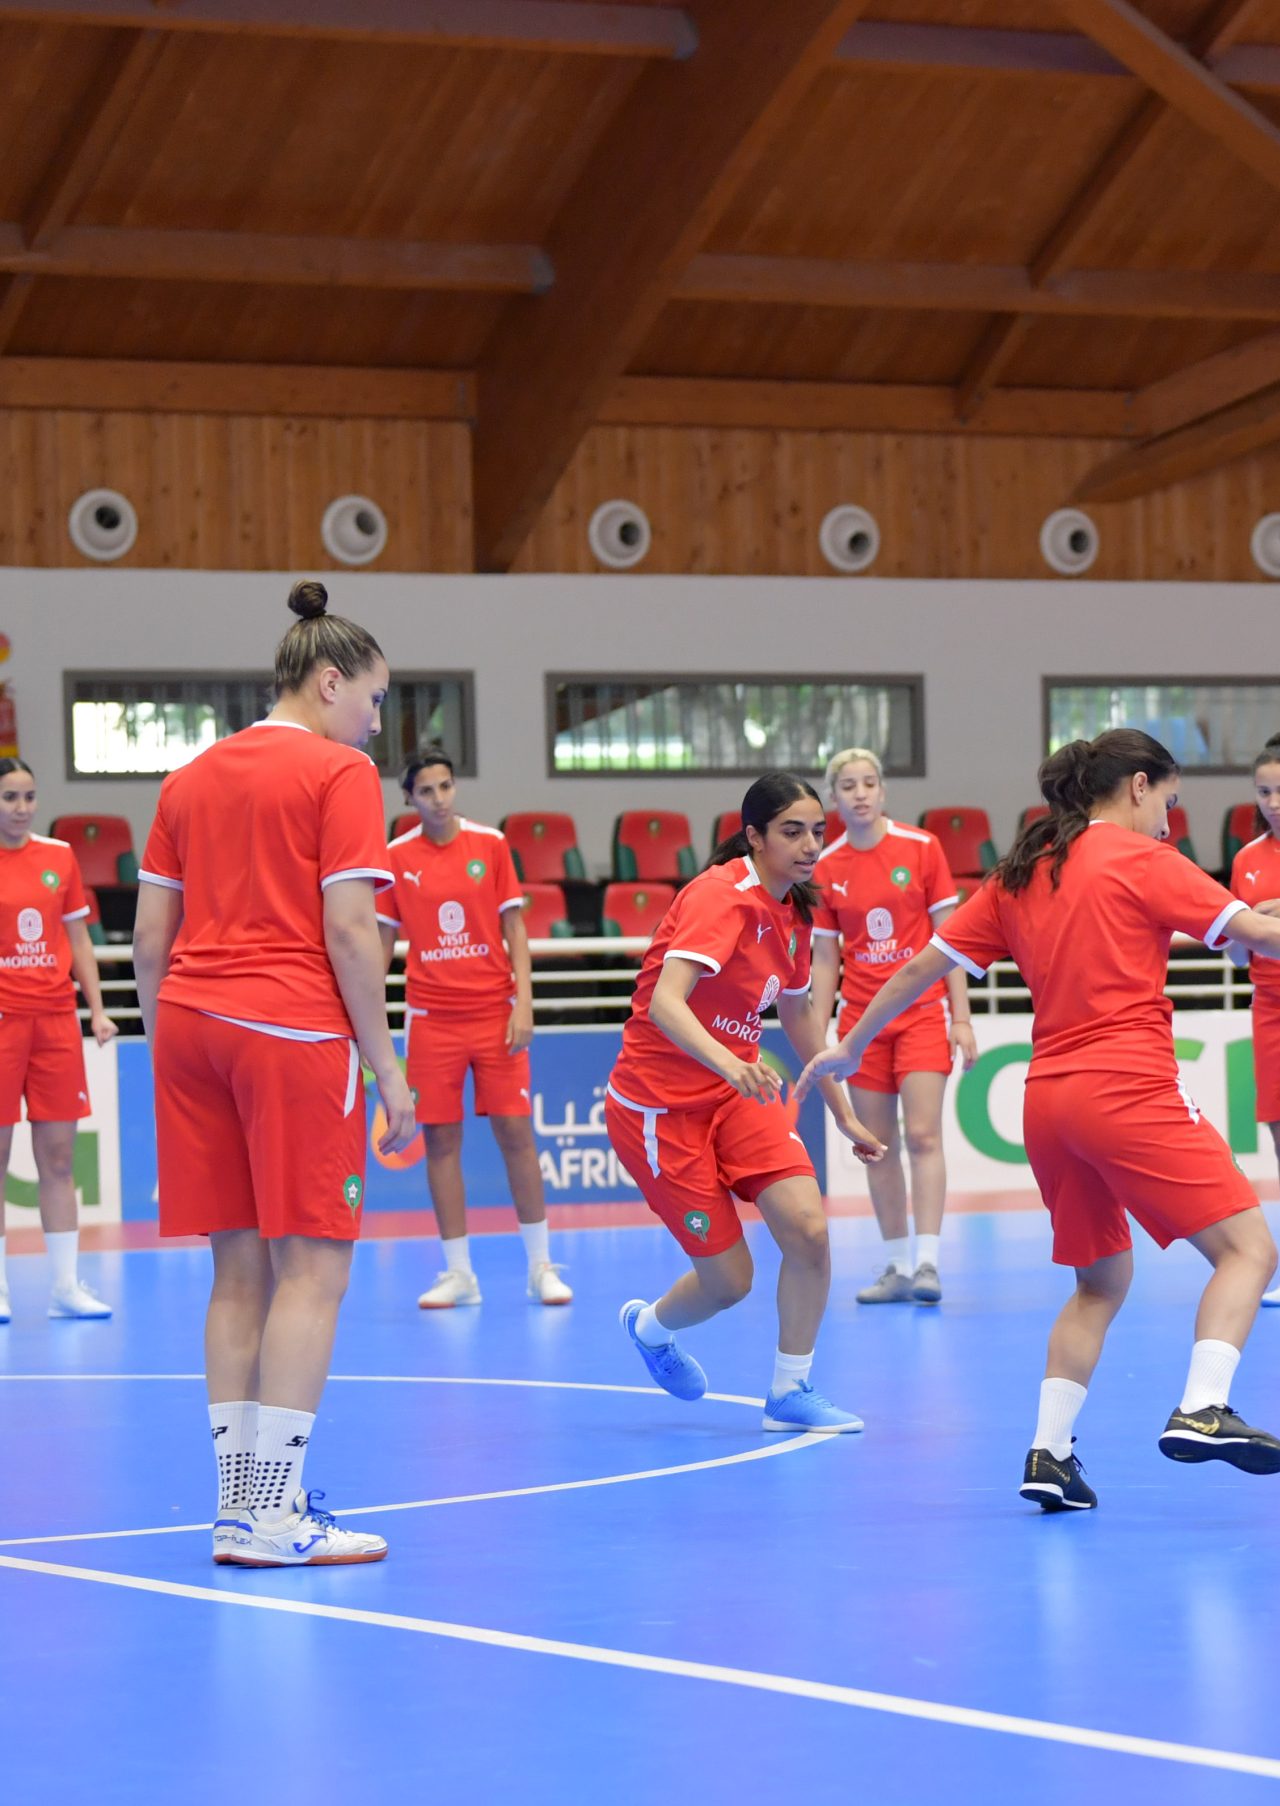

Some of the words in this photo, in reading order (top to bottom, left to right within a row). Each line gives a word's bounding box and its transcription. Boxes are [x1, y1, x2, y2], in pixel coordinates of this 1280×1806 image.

[438, 932, 470, 947] VISIT
[867, 939, 898, 953] VISIT
[15, 941, 47, 955] VISIT
[421, 944, 489, 962] MOROCCO
